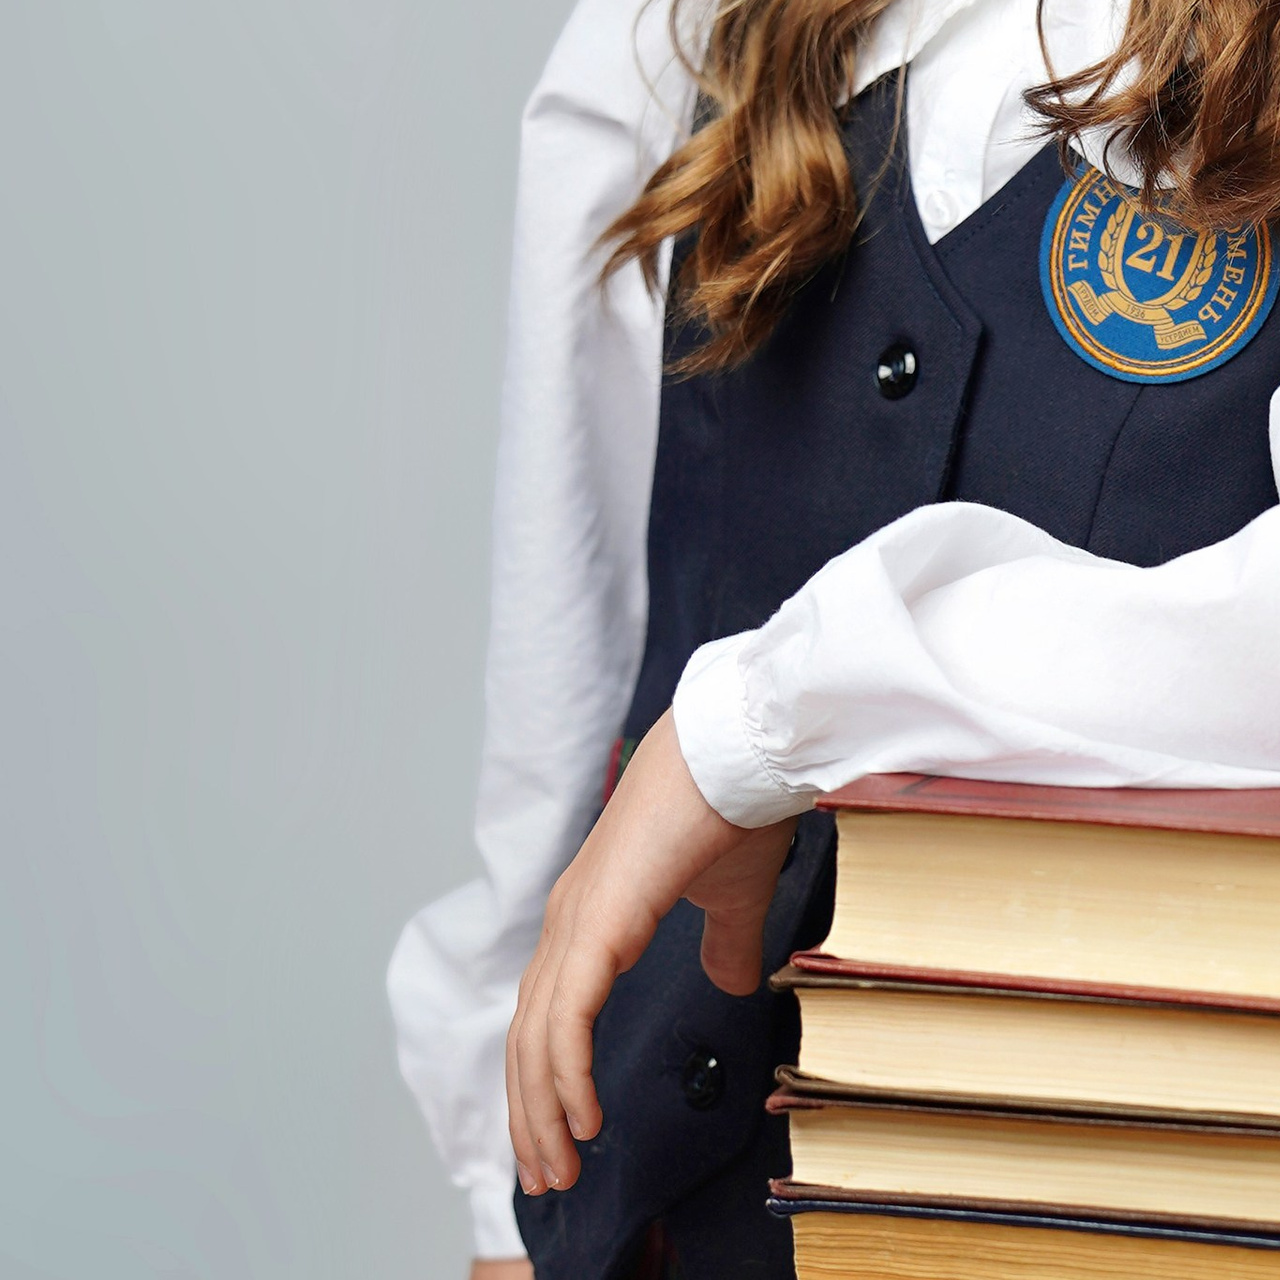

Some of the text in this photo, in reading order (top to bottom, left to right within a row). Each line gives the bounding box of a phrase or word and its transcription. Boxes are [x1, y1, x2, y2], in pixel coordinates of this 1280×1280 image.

[1068, 180, 1117, 271] ГИМН
[1125, 222, 1185, 281] 21
[1198, 226, 1247, 323] МЕНЬ
